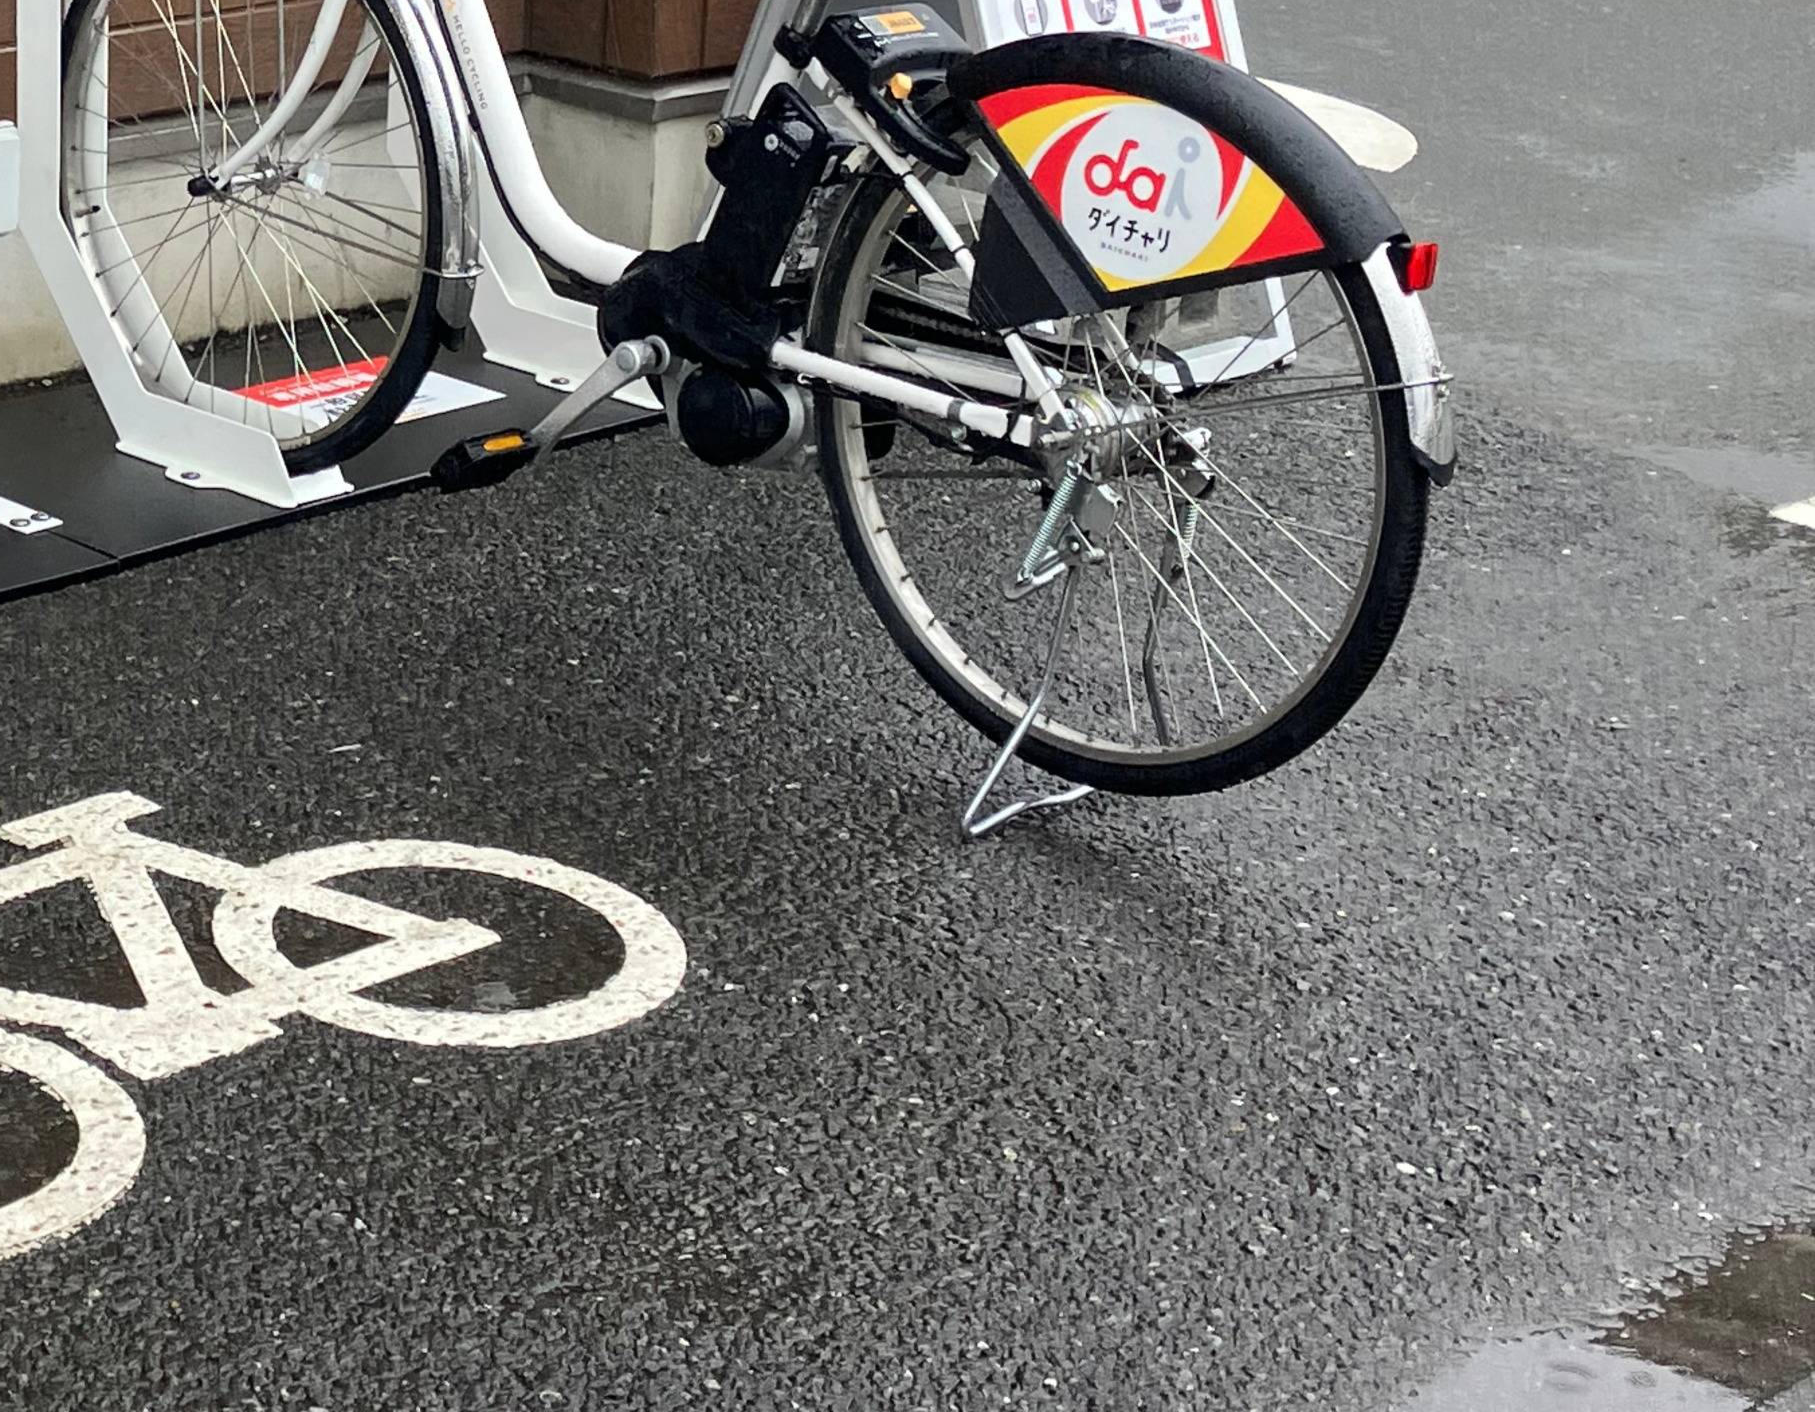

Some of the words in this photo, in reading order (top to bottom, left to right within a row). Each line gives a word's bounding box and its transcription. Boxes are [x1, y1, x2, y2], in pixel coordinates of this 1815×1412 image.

[452, 15, 471, 55] HELLO
[466, 58, 489, 110] CYCLING
[1084, 136, 1200, 221] dai
[1088, 207, 1171, 254] ダイチャリ
